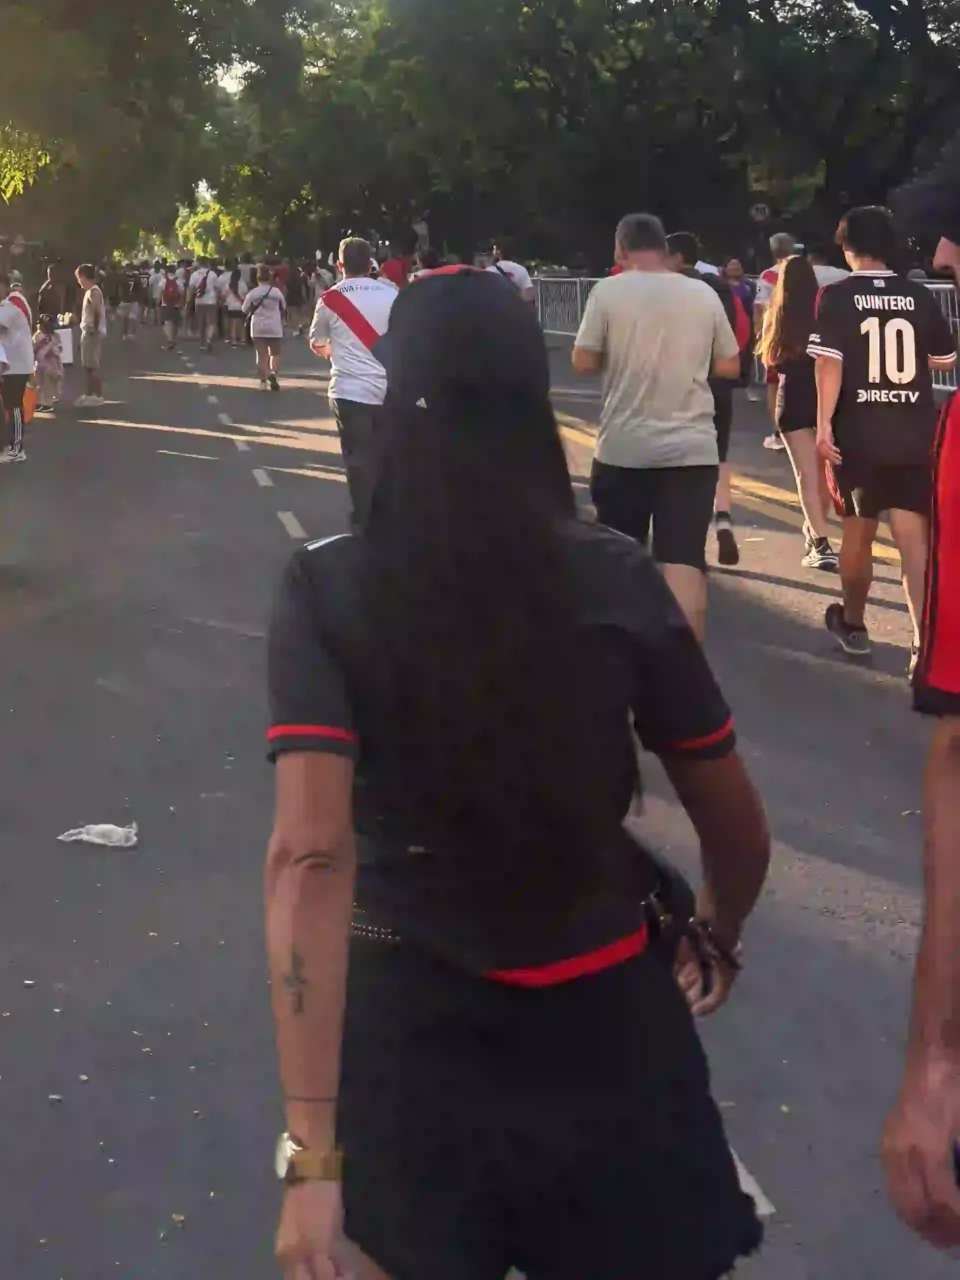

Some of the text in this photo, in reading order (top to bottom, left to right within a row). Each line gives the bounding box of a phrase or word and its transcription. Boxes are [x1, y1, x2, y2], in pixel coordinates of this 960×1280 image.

[854, 294, 915, 311] QUINTERO
[860, 316, 917, 385] 10
[856, 389, 920, 403] DIRECTV
